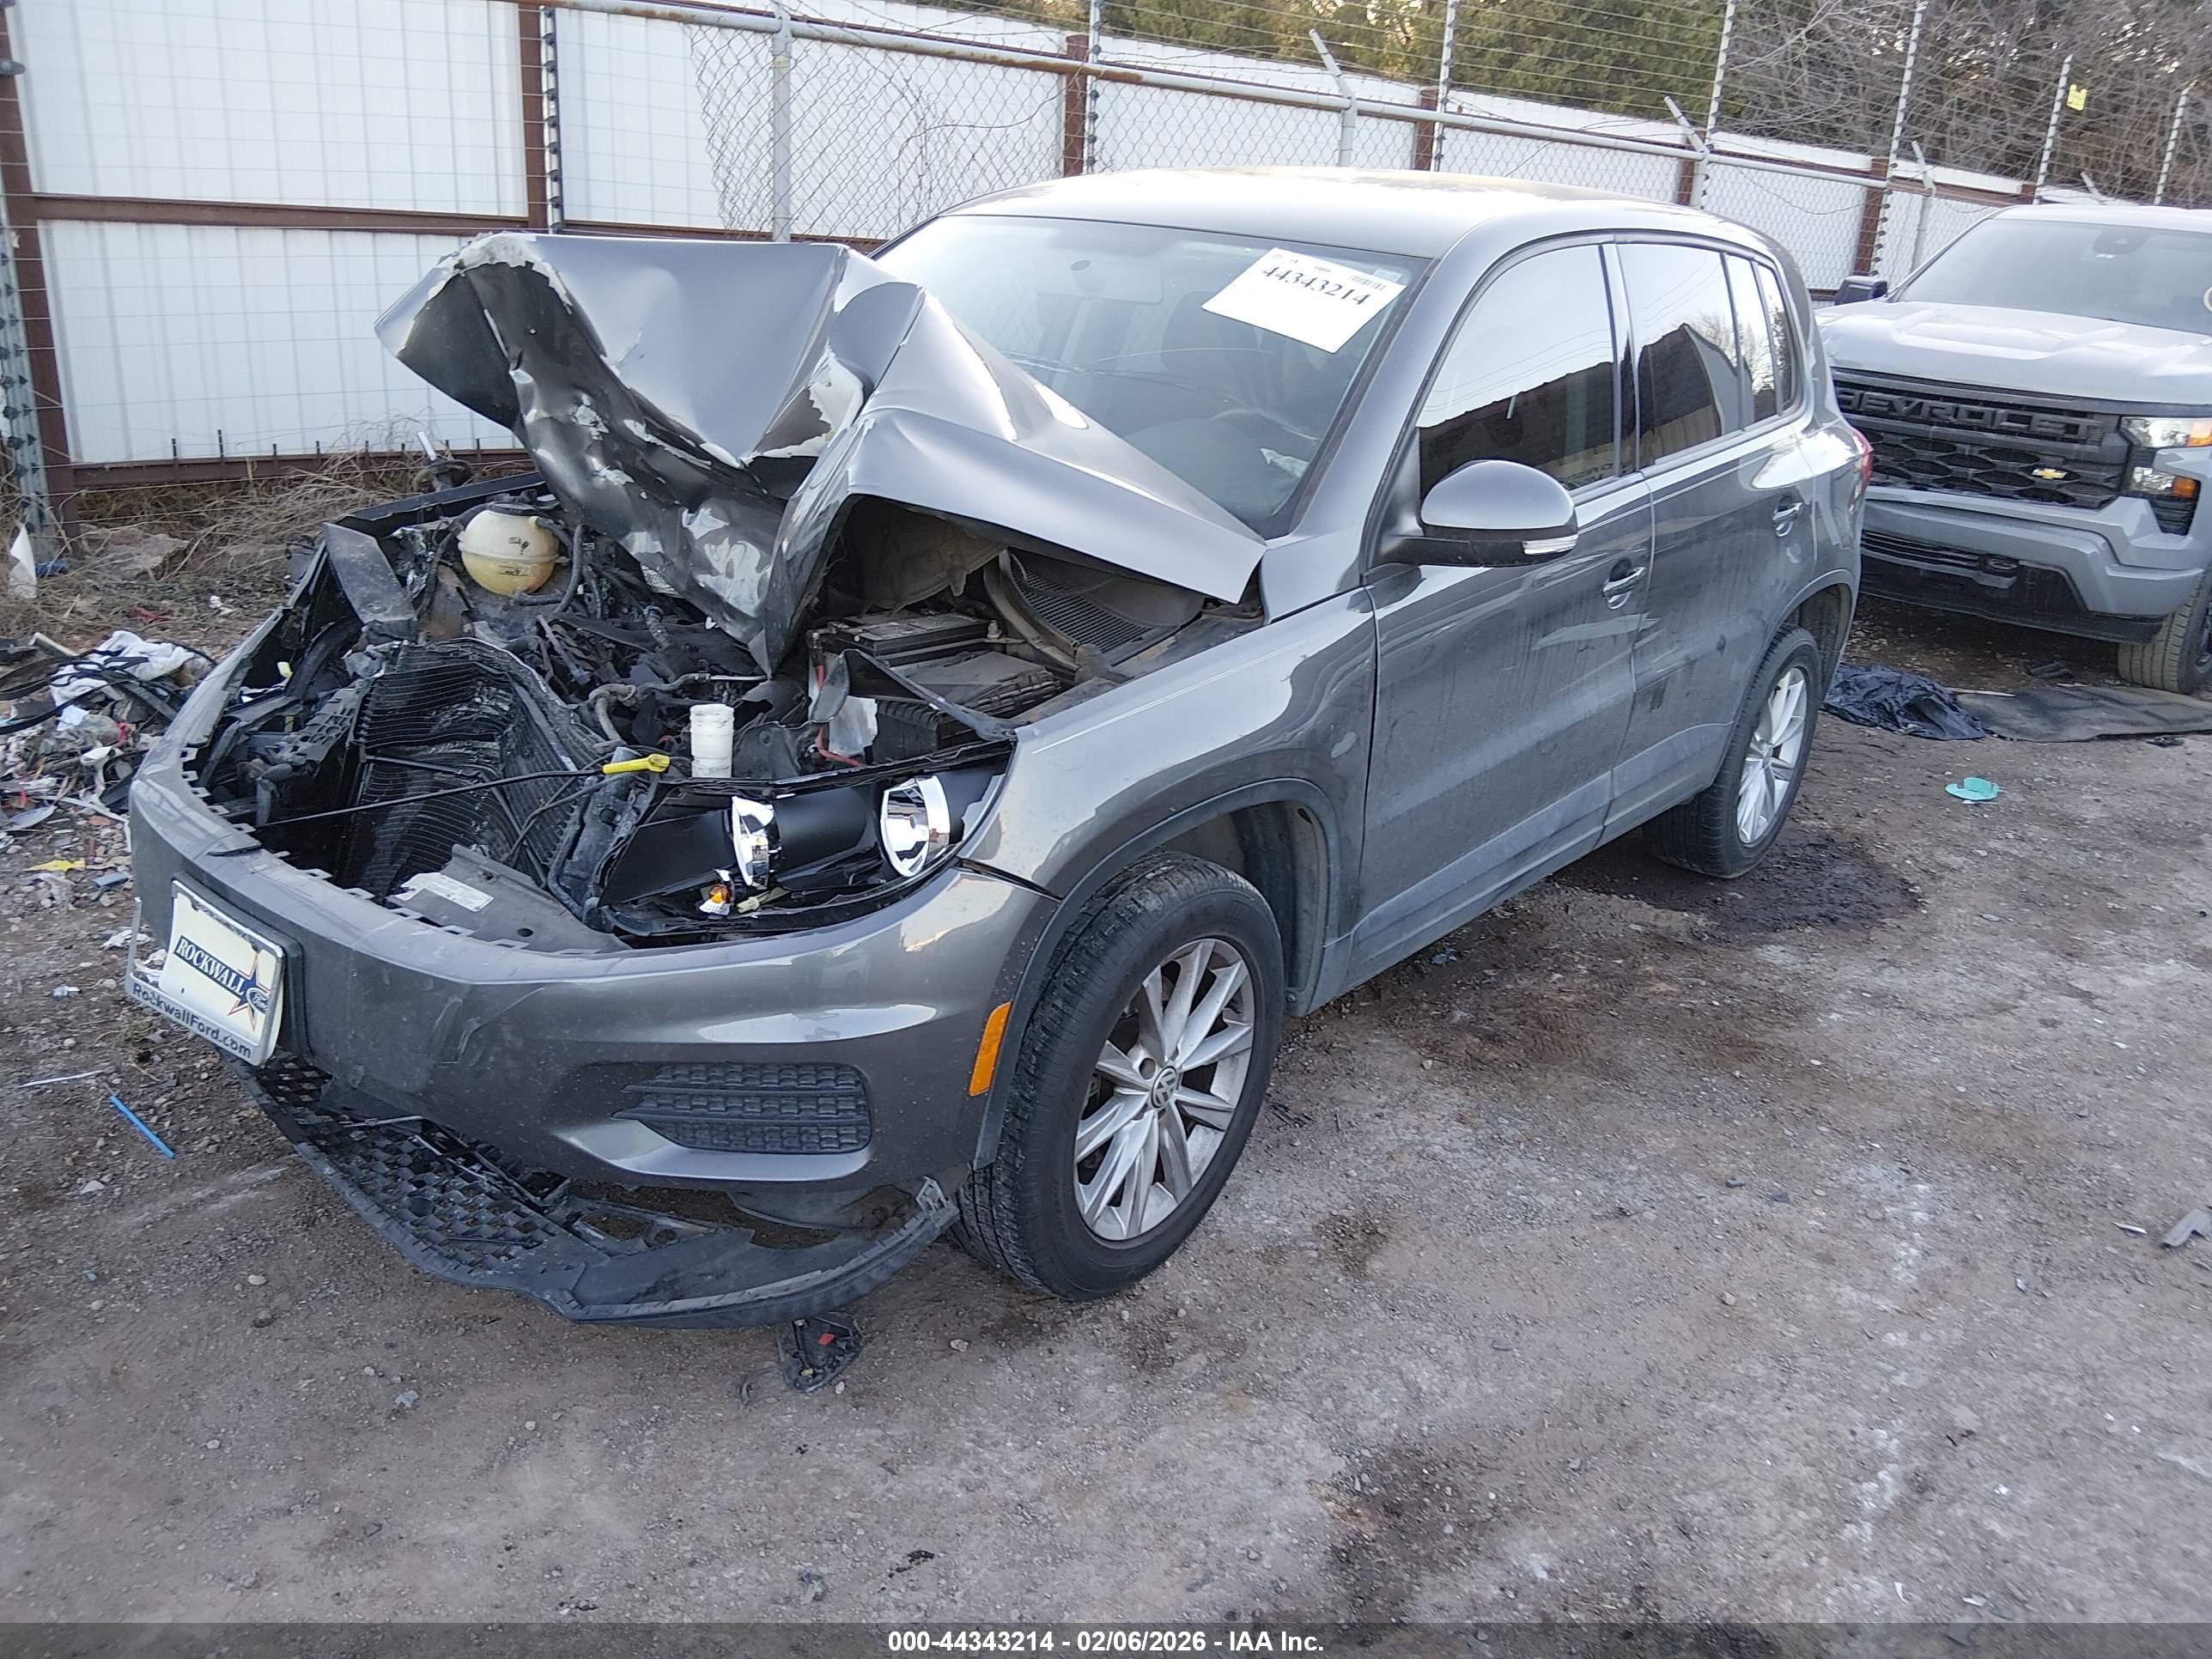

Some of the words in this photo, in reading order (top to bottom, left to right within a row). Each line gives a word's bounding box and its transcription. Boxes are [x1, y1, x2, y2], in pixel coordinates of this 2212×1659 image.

[1261, 265, 1372, 306] 44343214
[177, 939, 246, 996] ROCKWALL
[131, 984, 252, 1059] RockwallFord.com
